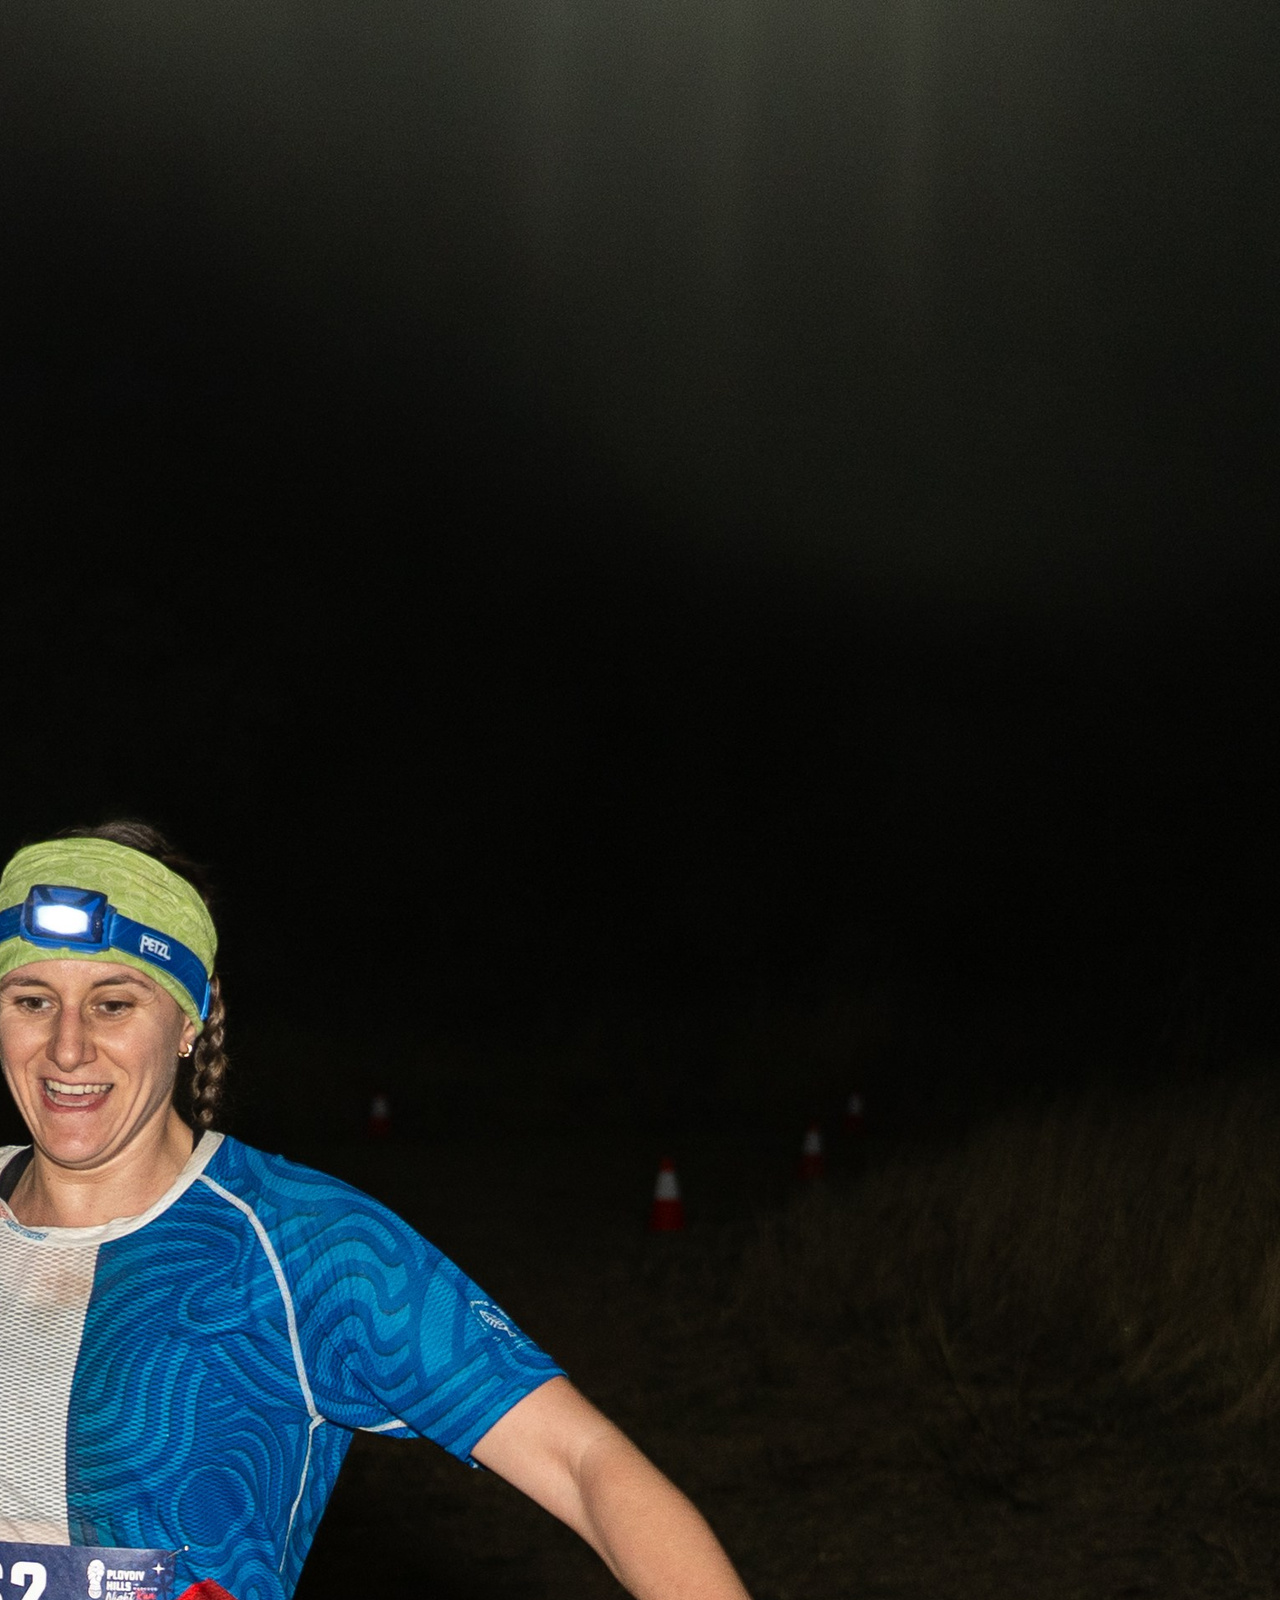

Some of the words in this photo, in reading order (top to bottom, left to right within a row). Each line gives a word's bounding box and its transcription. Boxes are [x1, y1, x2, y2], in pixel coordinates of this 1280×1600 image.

[139, 935, 171, 961] PETZL
[106, 1569, 145, 1581] PLOVDIV
[106, 1581, 132, 1591] HILLS
